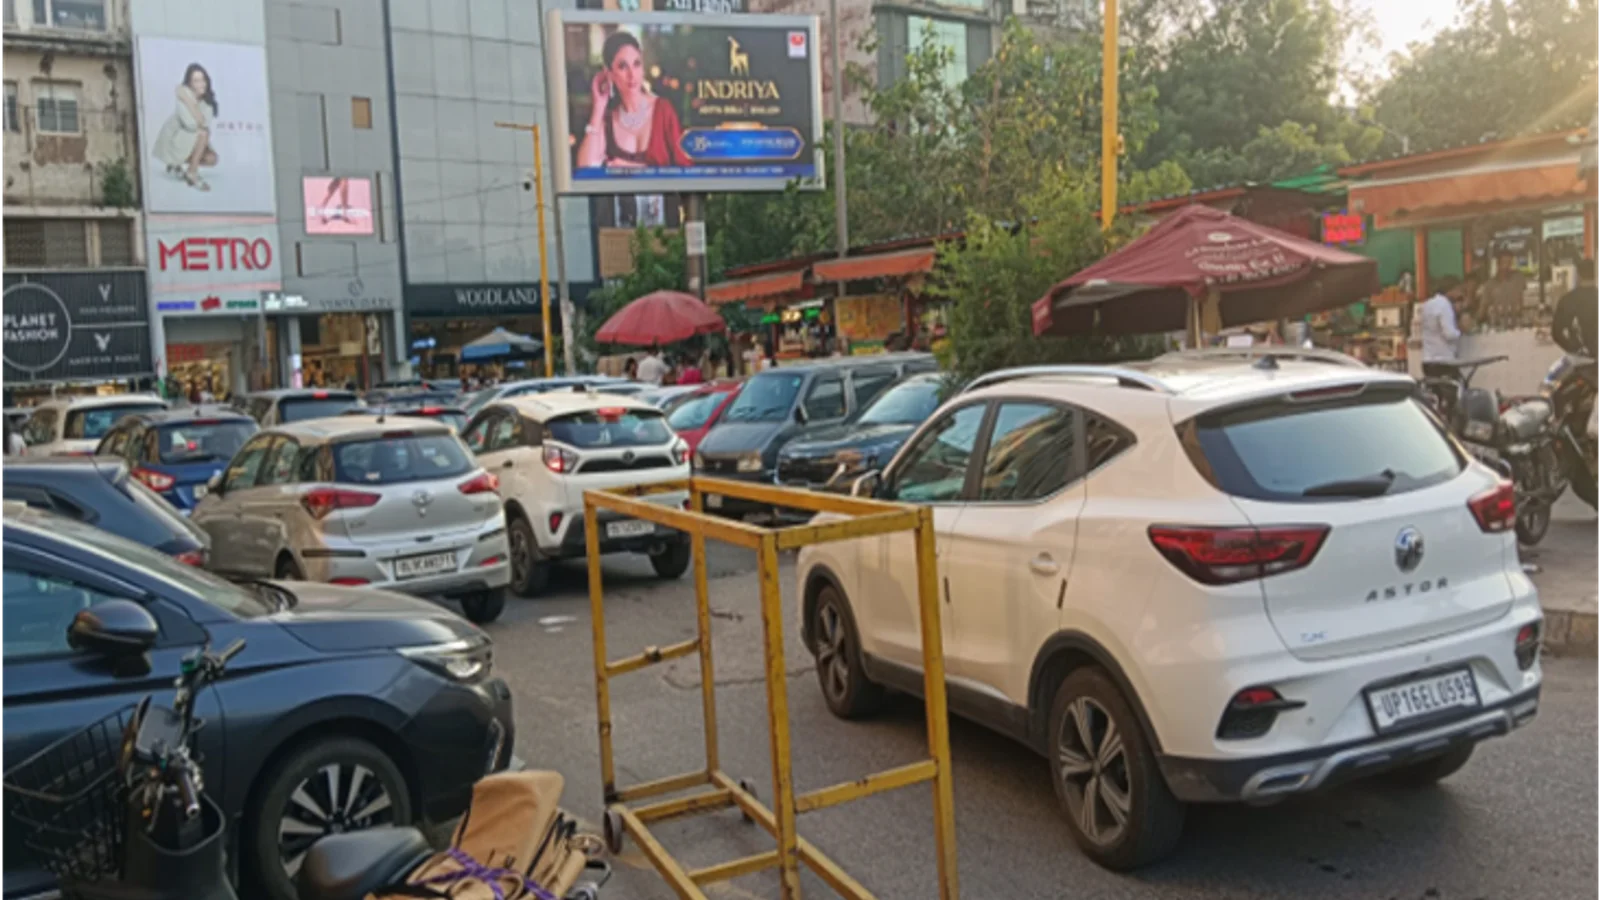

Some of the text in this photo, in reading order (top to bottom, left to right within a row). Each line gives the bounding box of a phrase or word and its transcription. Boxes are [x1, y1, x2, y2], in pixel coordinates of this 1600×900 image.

[697, 79, 780, 100] INDRIYA
[157, 236, 273, 272] METRO
[455, 286, 538, 306] WOODLAND
[2, 312, 56, 328] PLANET
[3, 328, 59, 342] FASHION
[1365, 575, 1448, 602] ASTOR
